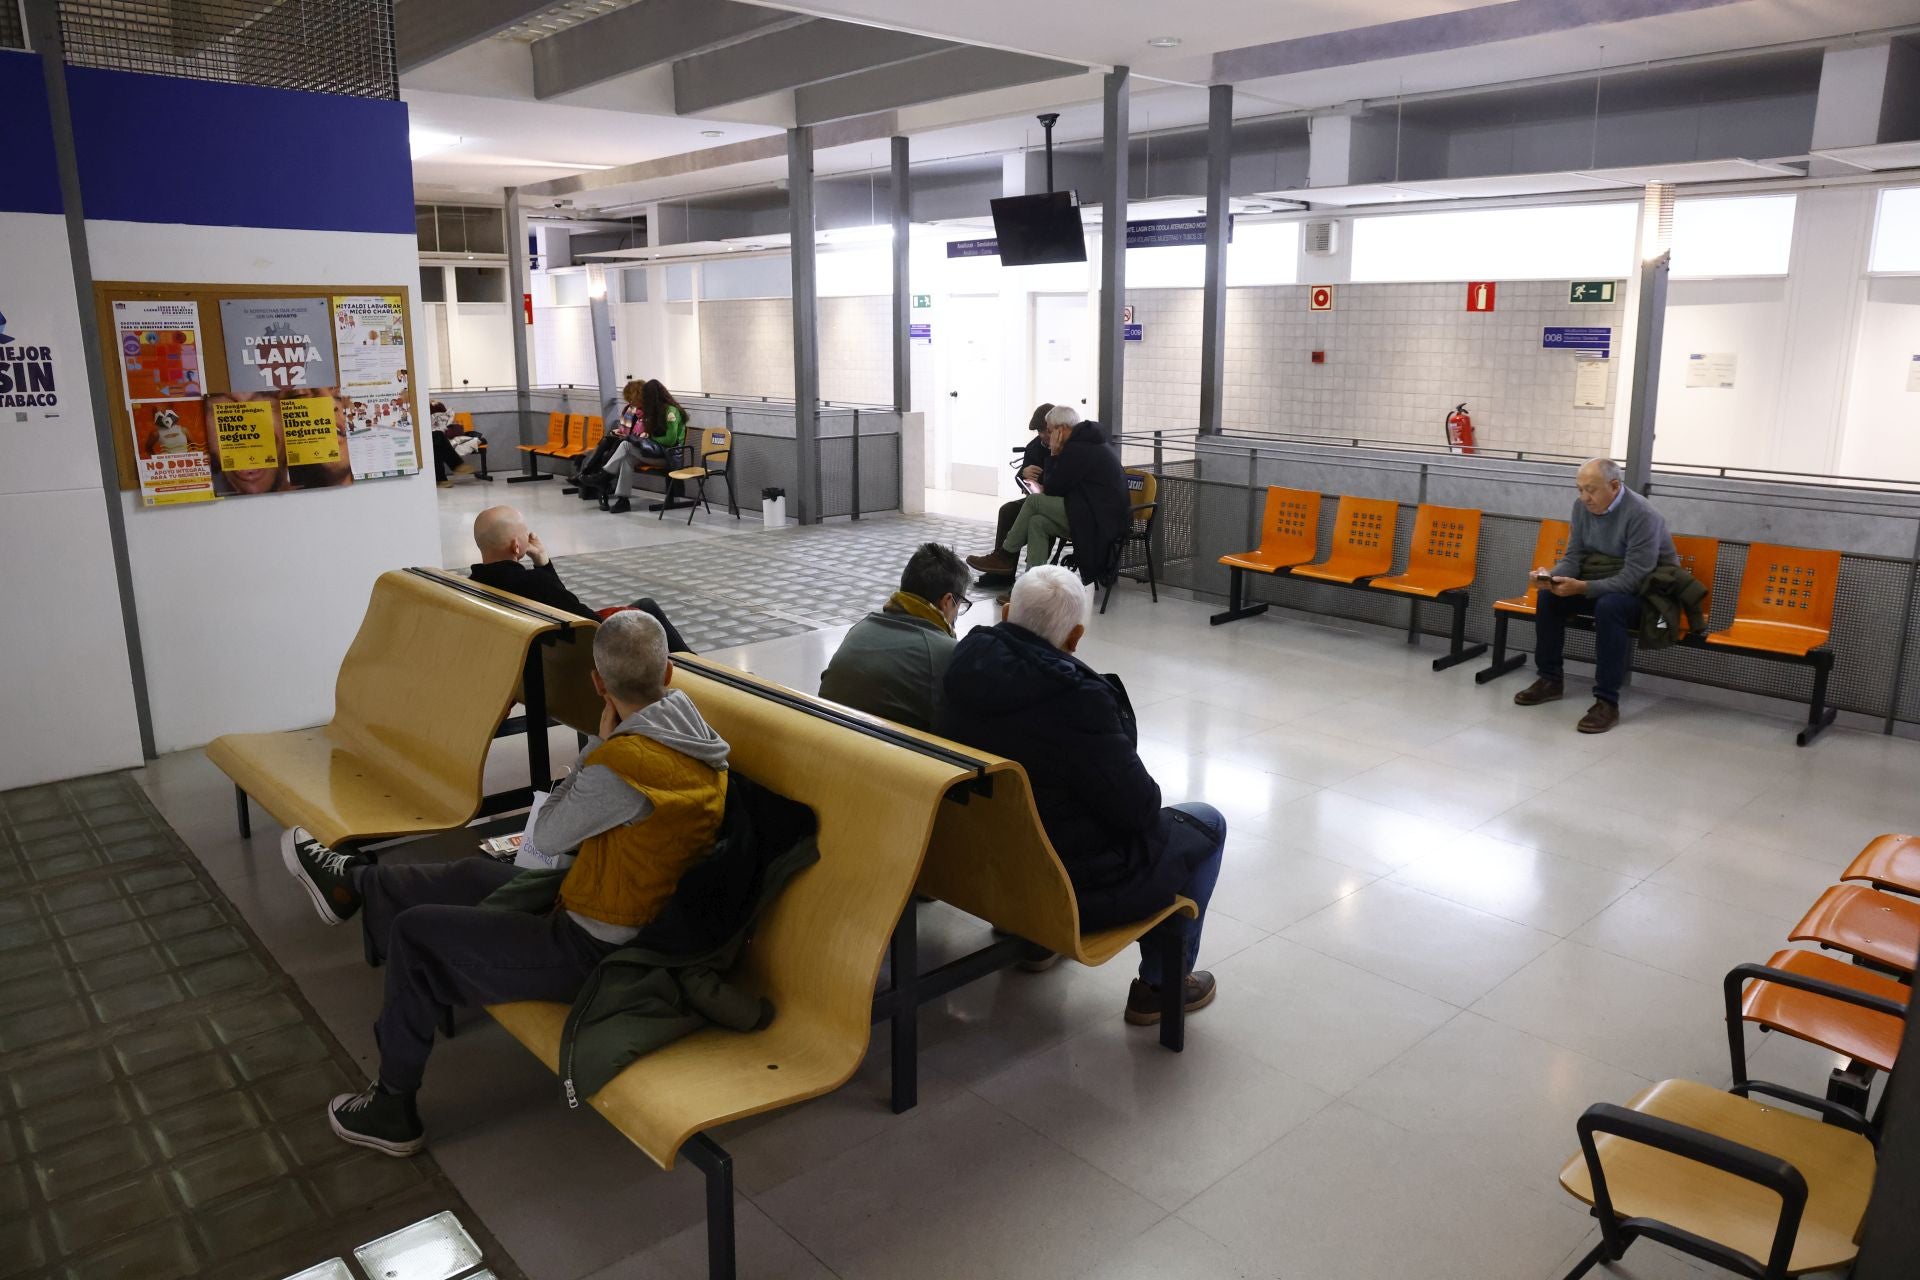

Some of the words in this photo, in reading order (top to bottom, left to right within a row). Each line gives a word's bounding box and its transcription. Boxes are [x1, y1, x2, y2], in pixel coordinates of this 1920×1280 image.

[245, 336, 278, 346] DATE
[280, 334, 311, 344] VIDA
[1545, 333, 1562, 342] 008
[242, 346, 322, 365] LLAMA
[0, 362, 55, 393] SIN
[259, 366, 307, 386] 112
[219, 423, 247, 432] libre
[284, 419, 311, 428] libre
[220, 432, 260, 442] seguro
[286, 427, 331, 438] segurua
[146, 461, 164, 470] NO
[168, 459, 210, 469] DUDES
